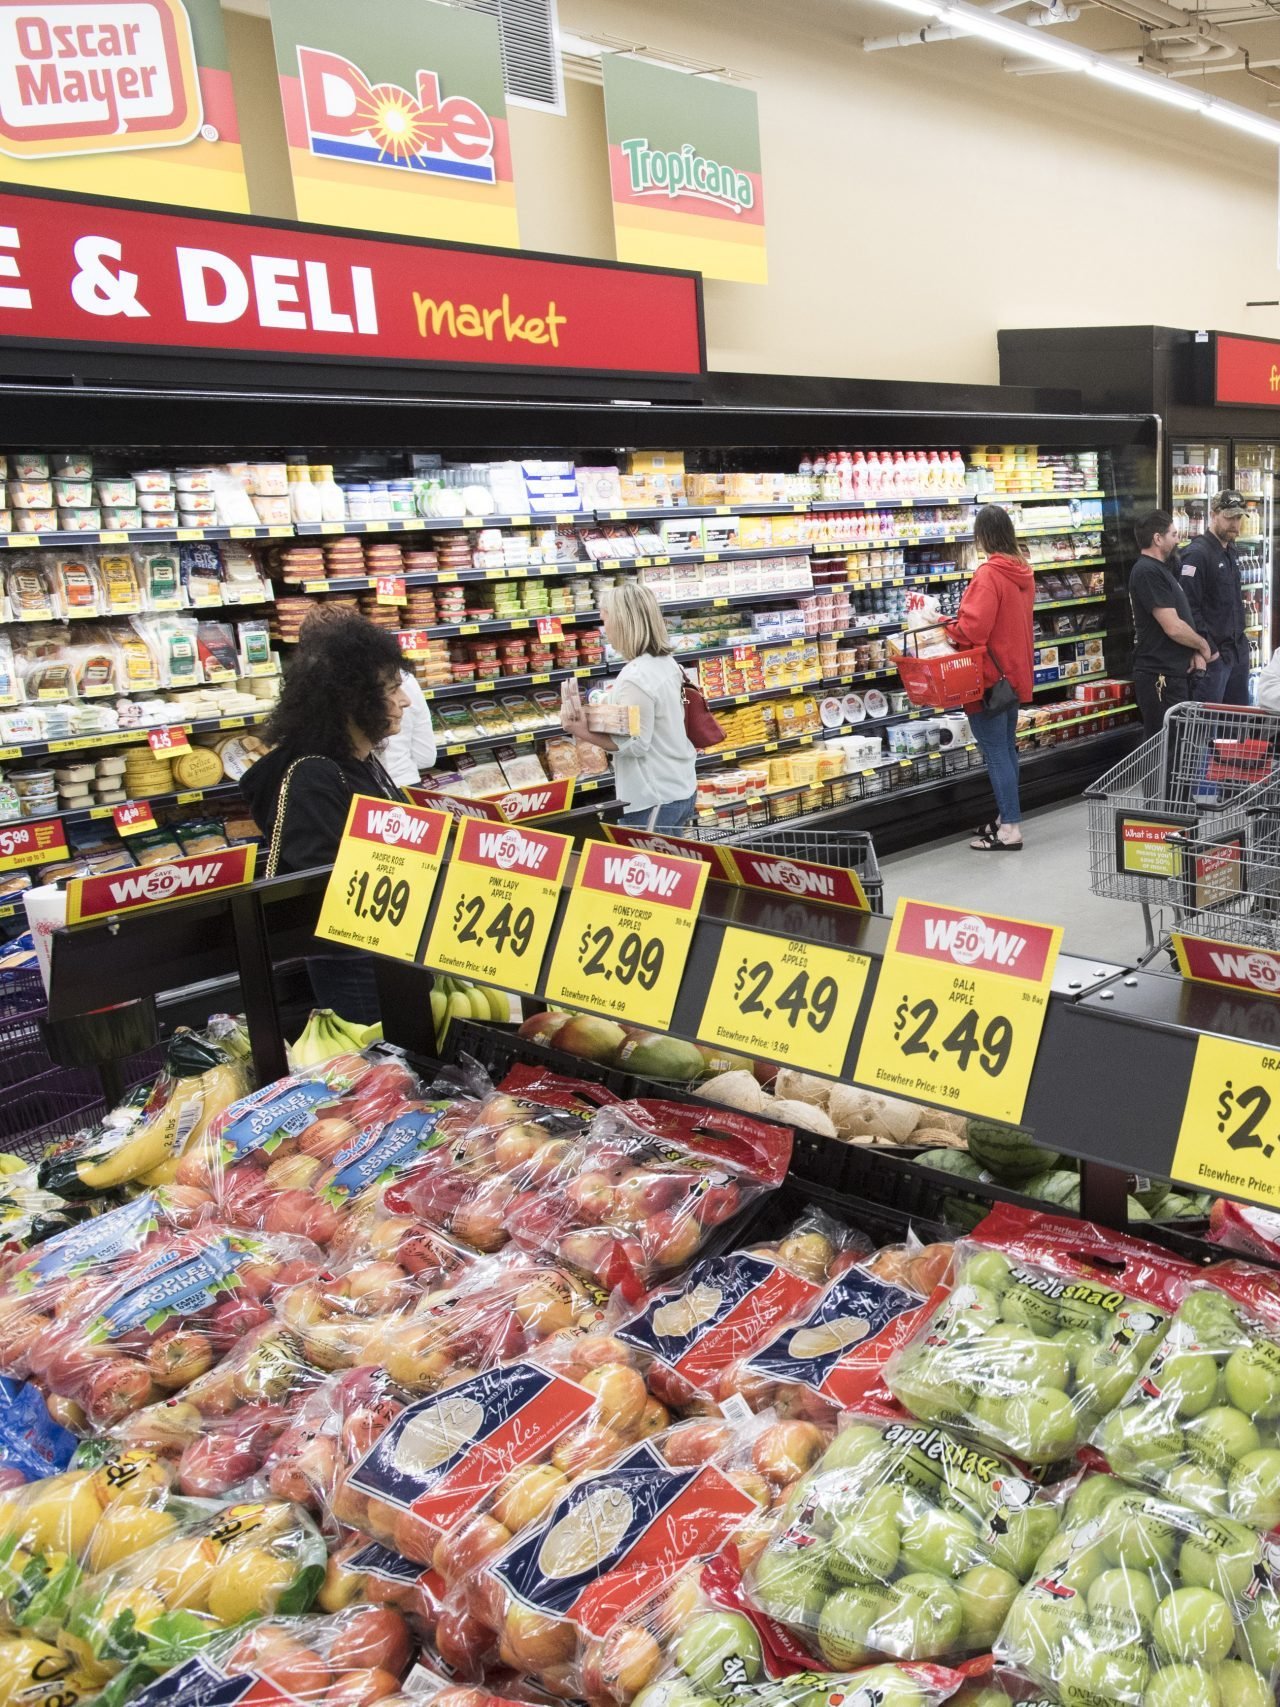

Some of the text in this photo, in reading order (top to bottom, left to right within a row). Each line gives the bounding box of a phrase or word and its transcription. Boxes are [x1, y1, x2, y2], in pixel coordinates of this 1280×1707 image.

[15, 17, 140, 60] Oscar
[15, 64, 157, 114] Mayer
[302, 49, 494, 161] Dole
[622, 139, 754, 206] Tropicana
[71, 235, 150, 319] &
[175, 246, 379, 335] DELI
[412, 291, 567, 348] market
[368, 806, 429, 844] WOW!
[1125, 830, 1144, 838] What
[1146, 830, 1152, 838] is
[372, 851, 406, 866] PACIFIC ROSE
[479, 829, 548, 869] WOW!
[109, 862, 223, 903] WOW!
[147, 873, 181, 892] 50%
[154, 870, 172, 878] SAVE
[376, 864, 395, 875] APPLES
[604, 854, 681, 897] WOW!
[752, 860, 834, 896] WOW!
[489, 876, 519, 890] PINK LADY
[491, 889, 512, 901] APPLES
[347, 870, 410, 927] $1.99
[453, 893, 535, 957] $2.49
[613, 904, 652, 921] HONEYCRISP
[618, 918, 642, 931] APPLES
[328, 925, 351, 938] Elsewhere
[352, 931, 365, 942] Price:
[924, 915, 1027, 966] WOW!
[963, 923, 980, 933] SAVE
[578, 923, 664, 991] $2.99
[781, 954, 808, 968] APPLES
[788, 942, 807, 954] OPAL
[439, 954, 497, 976] Elsewhere Price: $4.99
[856, 957, 867, 966] Bag
[1252, 958, 1270, 966] SAVE
[734, 958, 838, 1033] $2.49
[948, 991, 975, 1006] APPLE
[953, 978, 975, 993] GALA
[561, 987, 626, 1012] Elsewhere Price: $4.99
[1032, 995, 1043, 1005] Bag
[716, 1026, 789, 1054] Elsewhere Price: $3.99
[893, 995, 1013, 1078] $2.49
[876, 1068, 960, 1099] Elsewhere Price: $3.99
[1198, 1164, 1246, 1186] Elsewhere
[1248, 1176, 1275, 1195] Price:
[1041, 1309, 1090, 1329] RANCH
[483, 1385, 525, 1424] Apples
[478, 1418, 541, 1482] Apples
